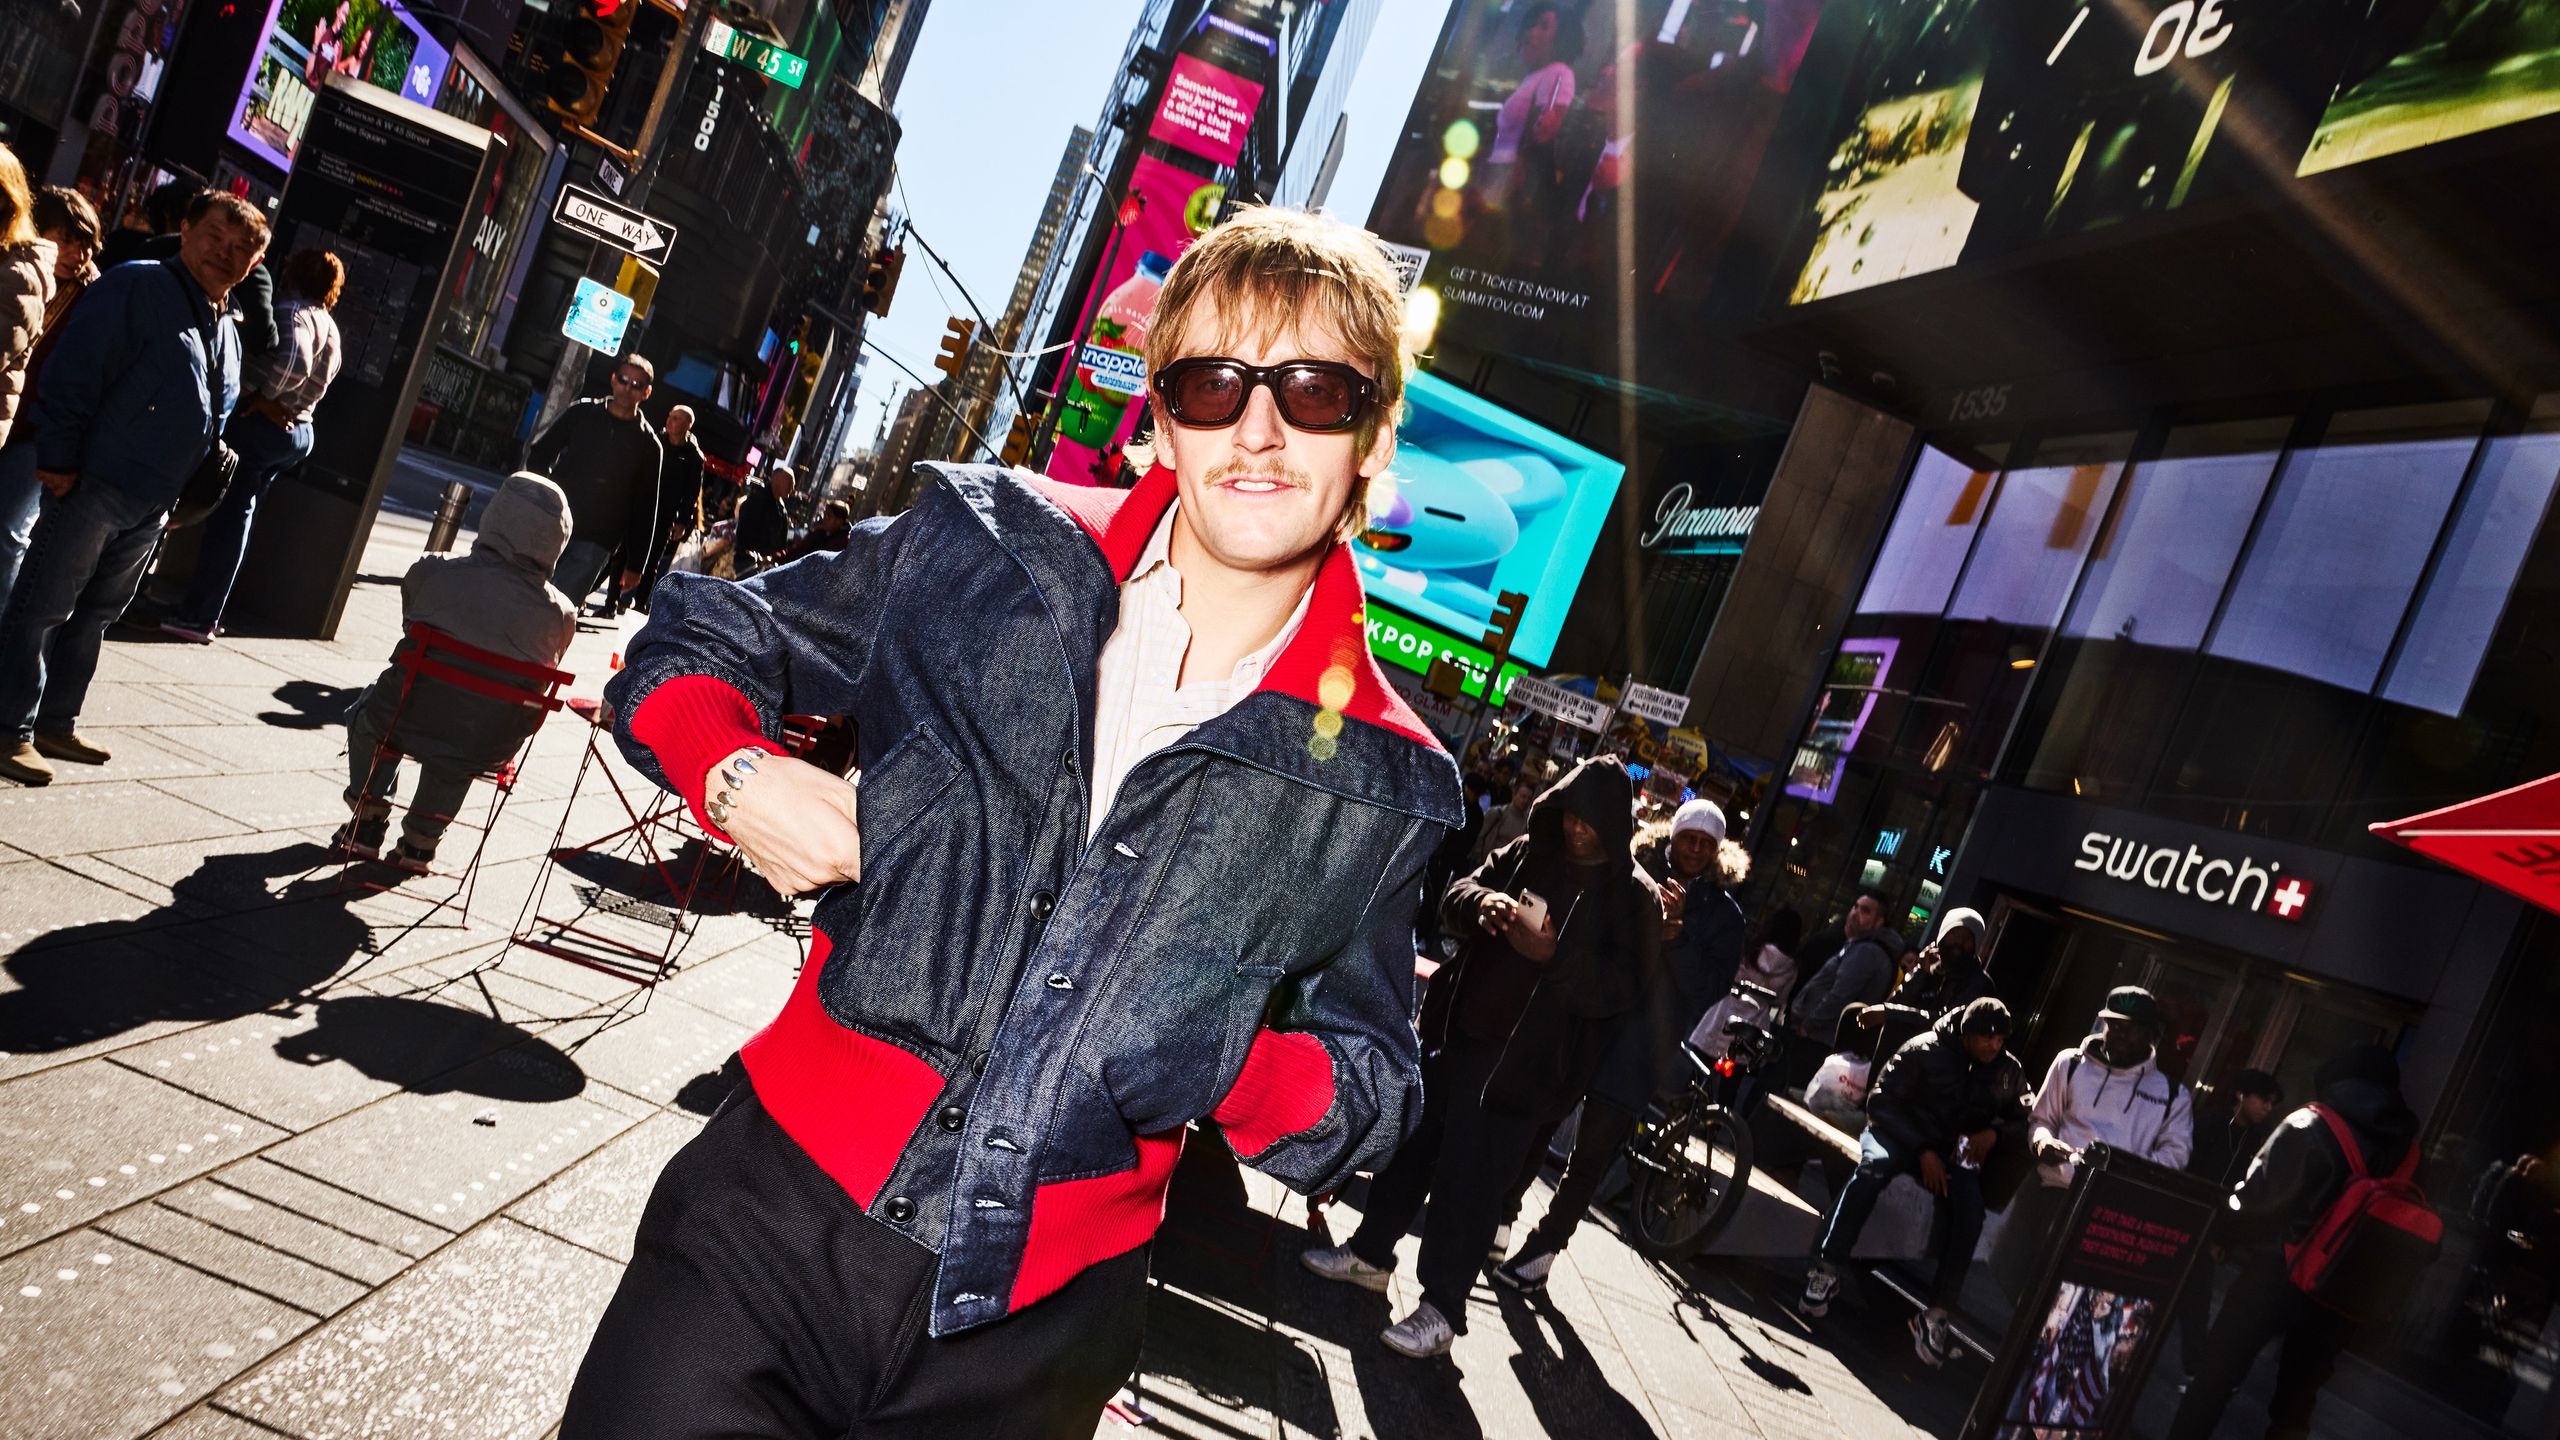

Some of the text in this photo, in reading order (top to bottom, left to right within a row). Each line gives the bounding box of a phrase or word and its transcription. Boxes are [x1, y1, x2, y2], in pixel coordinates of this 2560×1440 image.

[731, 35, 752, 60] W
[757, 47, 782, 75] 45
[788, 60, 804, 77] St
[1170, 86, 1247, 125] you just want
[1175, 73, 1238, 108] Sometimes
[694, 85, 724, 151] 1500
[1163, 107, 1230, 144] tastes good.
[1167, 98, 1231, 132] a drink that
[603, 164, 620, 190] ONE
[576, 204, 608, 227] ONE
[621, 222, 654, 246] WAY
[1442, 285, 1545, 320] SUMMITOV.COM
[1450, 265, 1591, 308] GET TICKETS NOW AT
[1366, 618, 1433, 658] KPOP
[1513, 688, 1559, 713] KEEP MOVING
[1517, 675, 1600, 716] PEDESTRIAN FLOW ZONE
[2074, 831, 2270, 912] swatch
